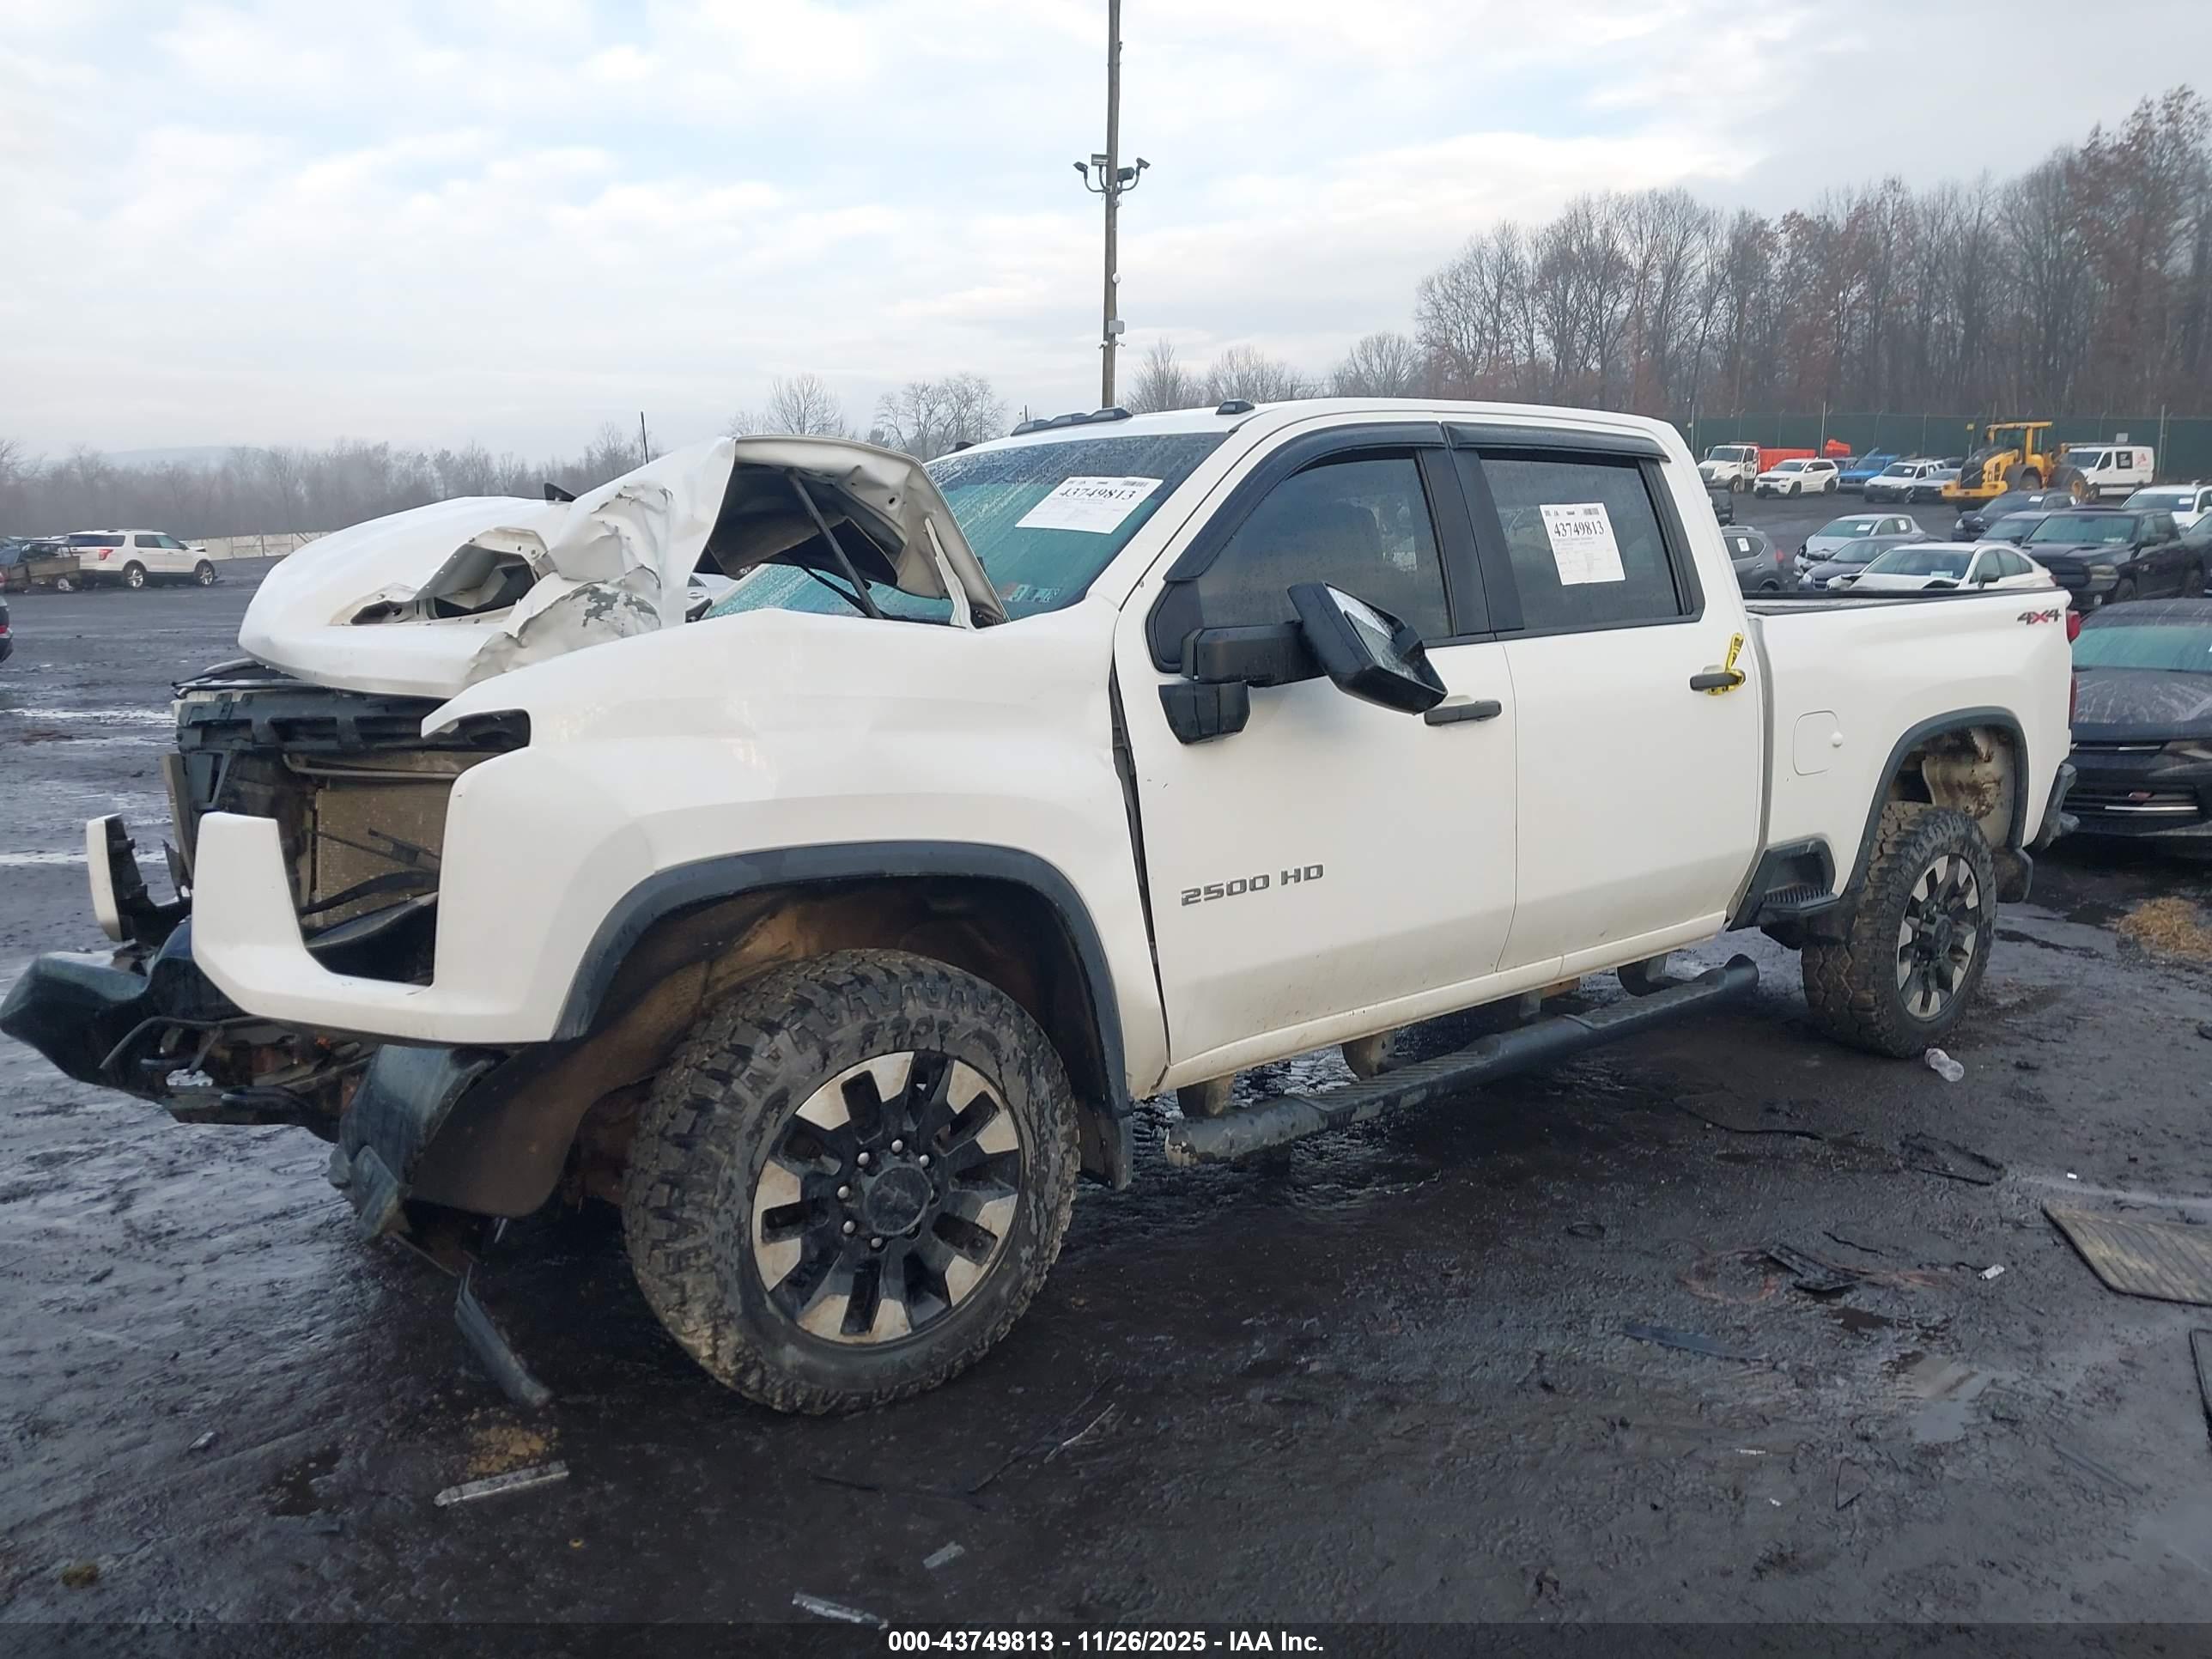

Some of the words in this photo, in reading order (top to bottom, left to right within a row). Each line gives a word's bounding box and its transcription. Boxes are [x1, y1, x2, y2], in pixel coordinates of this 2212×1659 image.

[1553, 520, 1605, 538] 43749813
[1181, 874, 1270, 907] 2500
[1280, 864, 1324, 886] HD
